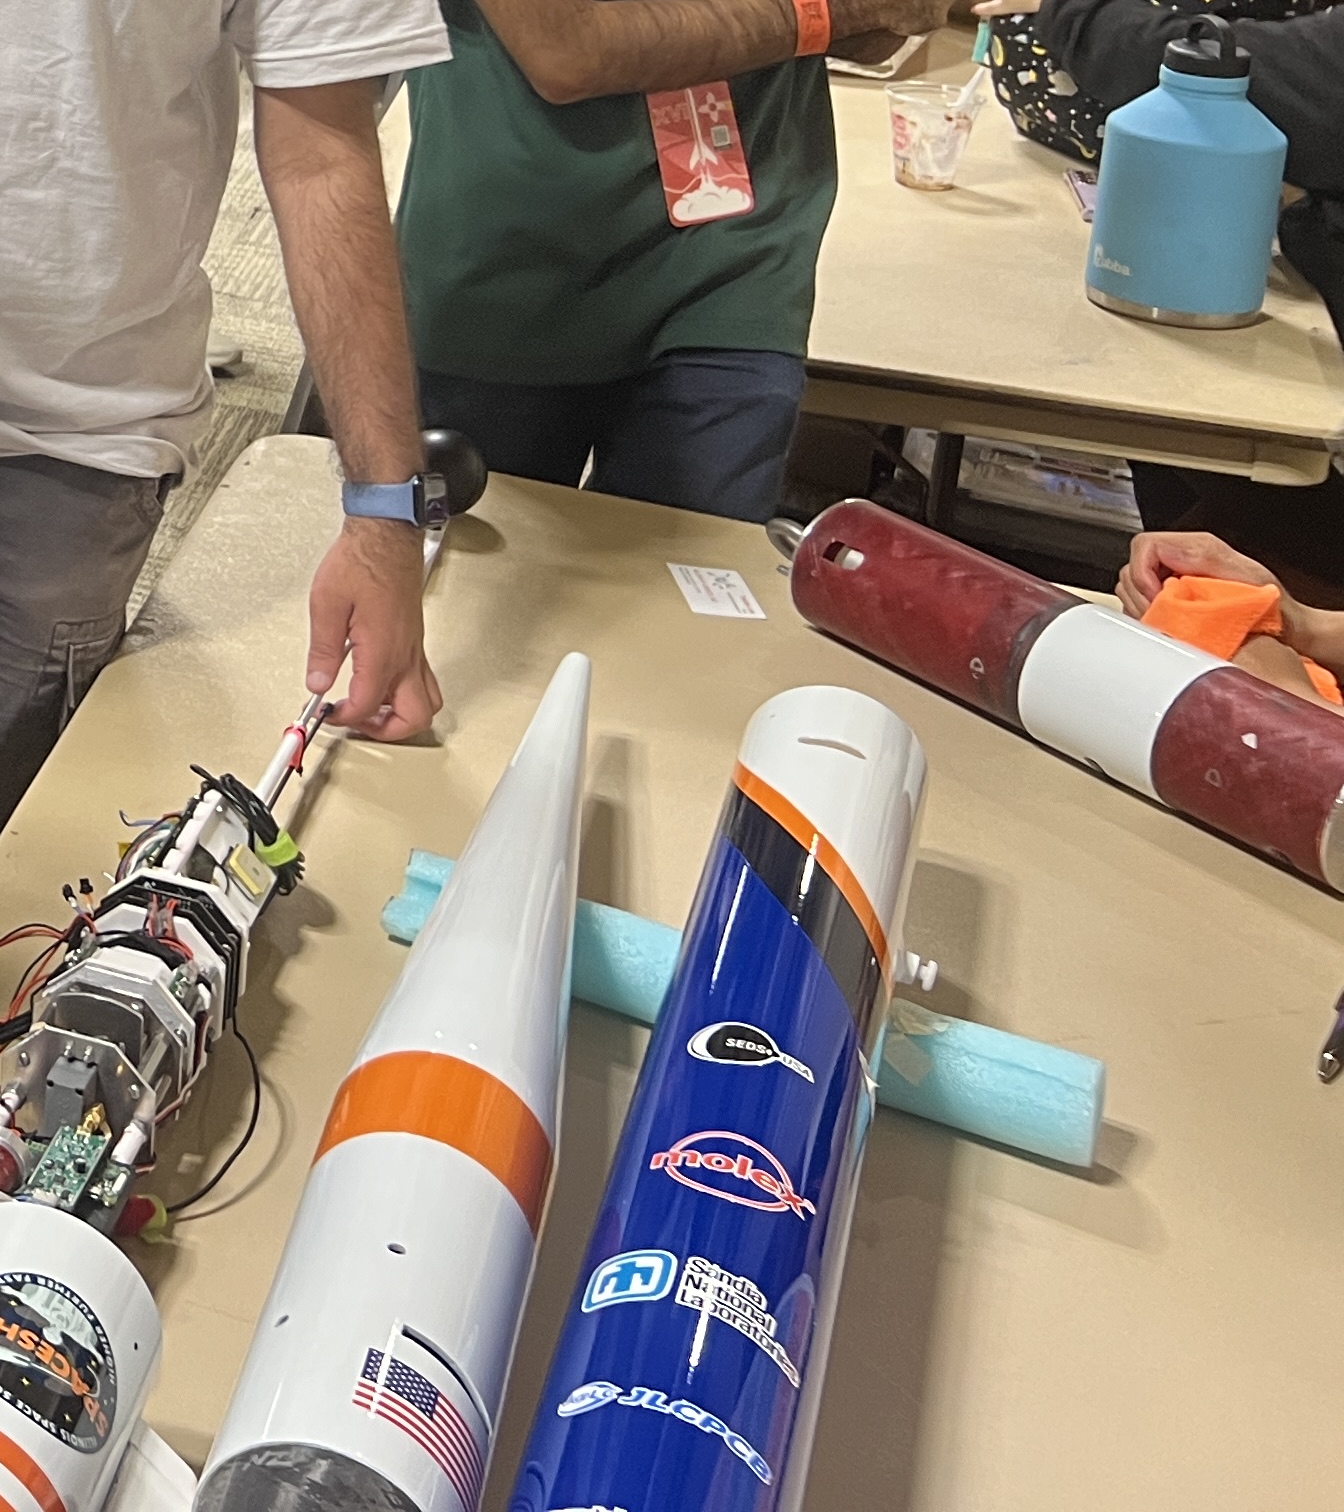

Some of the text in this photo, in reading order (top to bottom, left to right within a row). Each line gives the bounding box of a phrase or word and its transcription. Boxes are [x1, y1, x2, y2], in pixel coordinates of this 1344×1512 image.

[782, 1055, 811, 1078] USA
[649, 1149, 812, 1222] molex
[685, 1273, 773, 1332] National
[689, 1259, 763, 1306] Sandia
[15, 1399, 58, 1435] SPACE
[618, 1386, 774, 1486] JLCPCB
